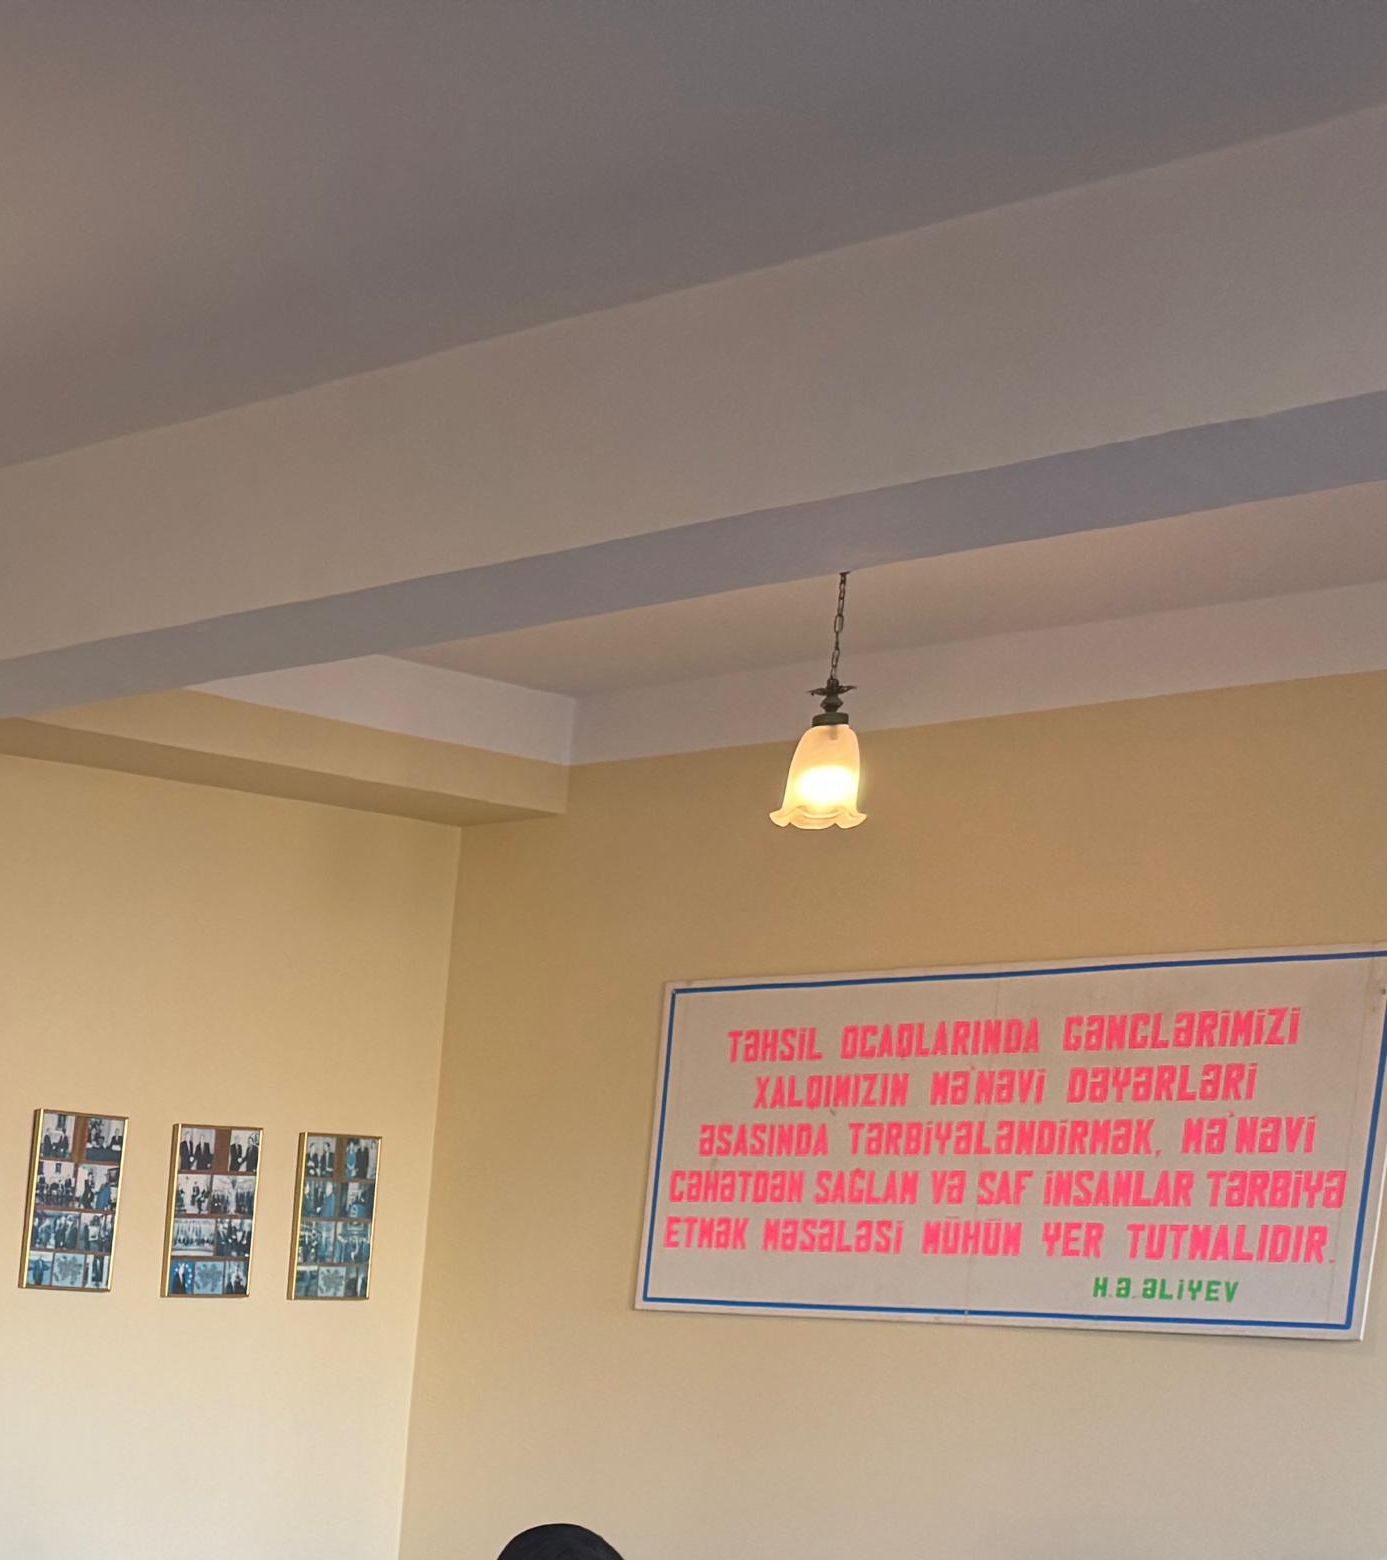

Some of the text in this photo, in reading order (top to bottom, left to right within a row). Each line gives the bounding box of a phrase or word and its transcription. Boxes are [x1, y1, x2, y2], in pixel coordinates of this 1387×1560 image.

[727, 1007, 1301, 1064] TƏHSİL OCAQLARINDA GƏNCLƏRİMİZİ
[754, 1072, 911, 1110] XALQIMIZIN
[1066, 1062, 1258, 1104] DƏYƏRLƏRİ
[699, 1122, 829, 1158] ƏSASINDA
[669, 1168, 1348, 1210] CƏHƏTDƏN SAĞLAM VƏ SAF İNSANLAR TƏRBİYƏ
[664, 1216, 750, 1251] ETMƏK
[763, 1218, 904, 1255] MƏSƏLƏSİ
[922, 1217, 1023, 1257] MÜHÜM
[1042, 1220, 1106, 1259] YER
